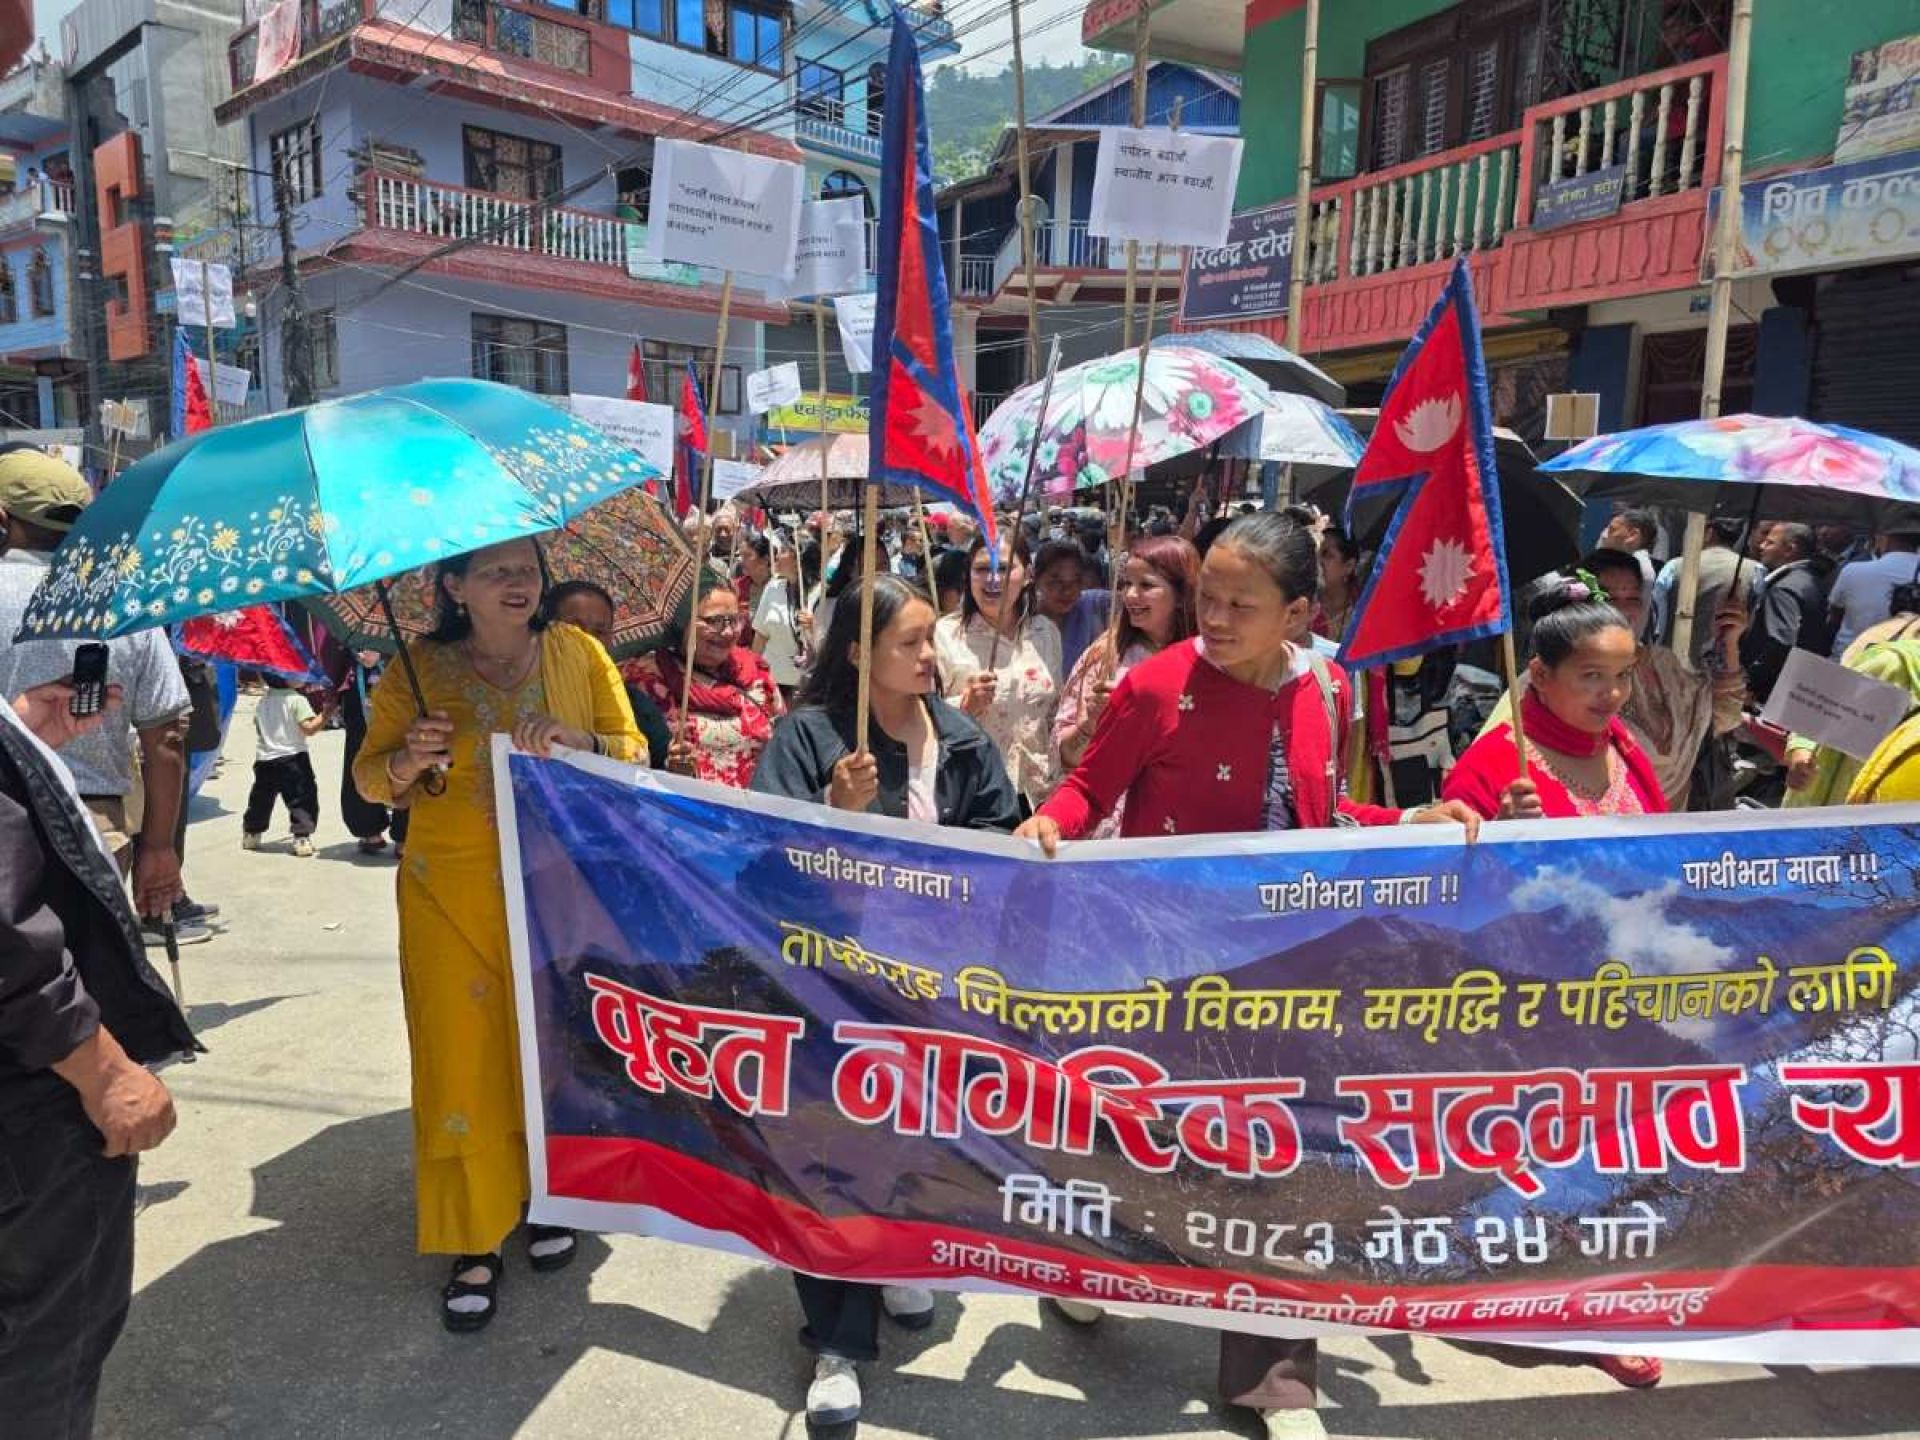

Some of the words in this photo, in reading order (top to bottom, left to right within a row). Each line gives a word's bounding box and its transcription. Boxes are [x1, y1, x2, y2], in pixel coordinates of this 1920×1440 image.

[785, 846, 887, 888] पाथीभरा
[890, 865, 953, 900] माता
[961, 875, 971, 902] !
[1258, 871, 1366, 913] पाथीभरा
[1370, 875, 1433, 908] माता
[1439, 874, 1460, 903] !!
[1682, 851, 1780, 890] पाथीभरा
[1784, 854, 1842, 885] माता
[1848, 853, 1880, 882] !!!
[780, 919, 943, 1001] ताप्लेजुङ
[954, 965, 1172, 1034] जिल्लाको
[1183, 975, 1345, 1038] विकास,
[1364, 970, 1507, 1044] समृद्धि
[1516, 984, 1546, 1029] र
[1557, 957, 1780, 1031] पहिचानको
[1788, 946, 1898, 1011] लागि
[584, 972, 806, 1117] वृहत
[833, 1020, 1305, 1179] नागरिक
[1335, 1062, 1748, 1201] सद्भाव
[998, 1173, 1123, 1238] मिति
[1185, 1211, 1335, 1271] २०८३
[1365, 1204, 1453, 1265] जेठ
[1475, 1215, 1549, 1264] २४
[1579, 1201, 1668, 1261] गते
[1406, 1299, 1467, 1329] युवा
[1472, 1292, 1571, 1321] समाज,
[1582, 1281, 1715, 1326] ताप्लेजुङ
